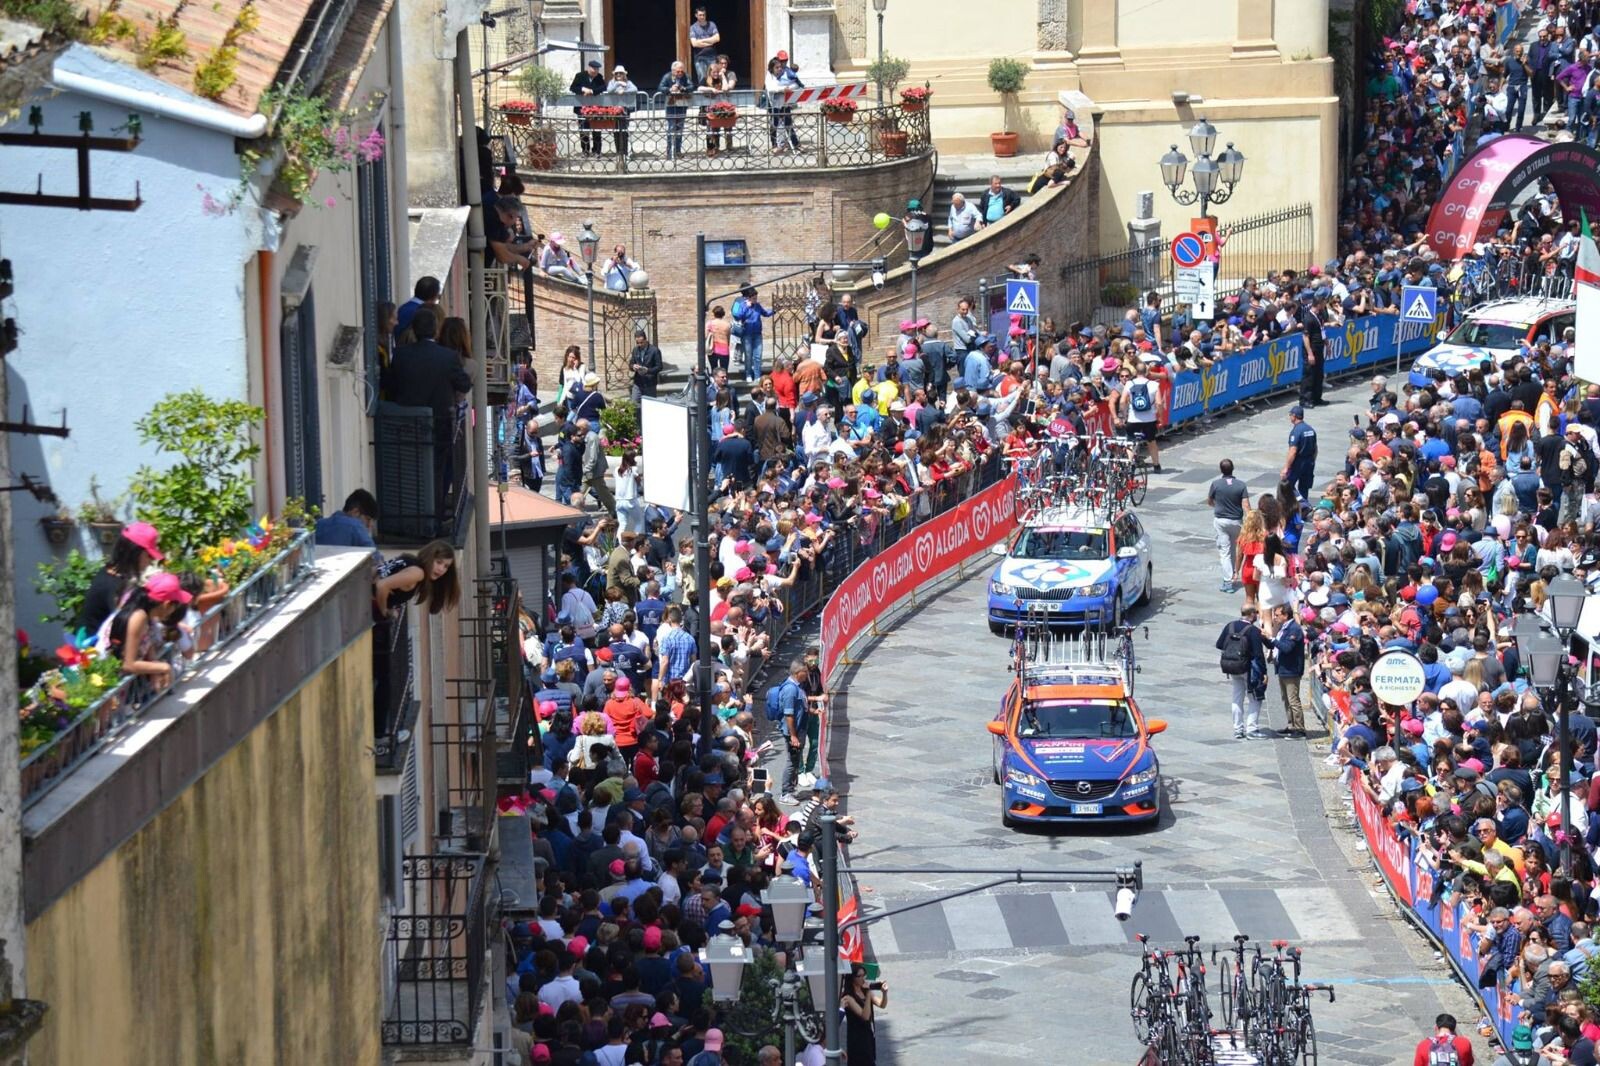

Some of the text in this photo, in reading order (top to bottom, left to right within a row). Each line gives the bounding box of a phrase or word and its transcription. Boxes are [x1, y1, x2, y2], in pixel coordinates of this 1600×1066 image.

[1457, 178, 1497, 195] enel
[1444, 202, 1483, 220] enel
[1434, 230, 1473, 249] enel
[1343, 320, 1379, 365] Spin
[1237, 340, 1300, 388] EURO Spin
[1172, 380, 1200, 410] EURO
[1198, 362, 1229, 409] Spin
[992, 490, 1015, 527] ALGID
[935, 520, 970, 559] ALGIDA
[887, 551, 914, 590] ALGIDA
[851, 578, 872, 620] ALGIDA
[1375, 675, 1421, 684] FERMATA
